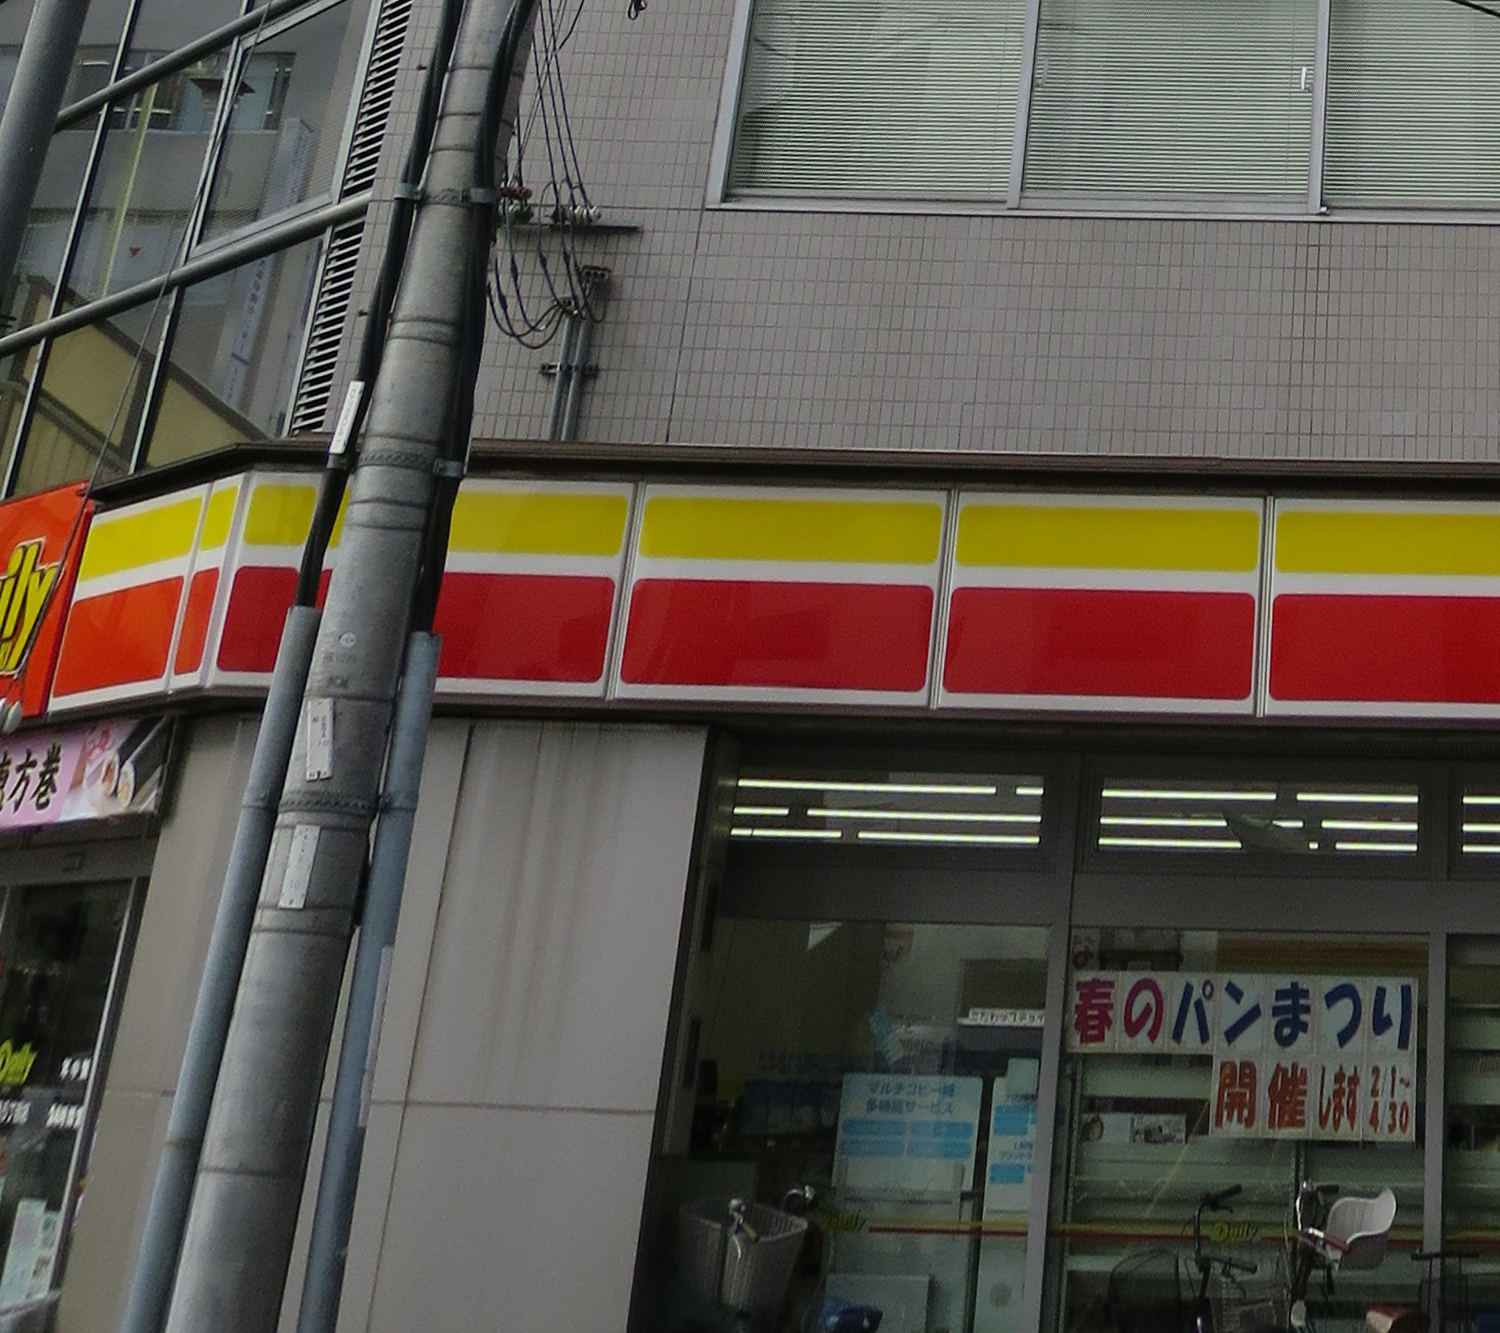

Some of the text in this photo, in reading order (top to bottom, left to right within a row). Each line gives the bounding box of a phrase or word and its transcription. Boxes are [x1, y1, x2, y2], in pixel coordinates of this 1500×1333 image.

[1073, 977, 1413, 1051] 春のパンまつり
[1214, 1060, 1360, 1133] 開催します
